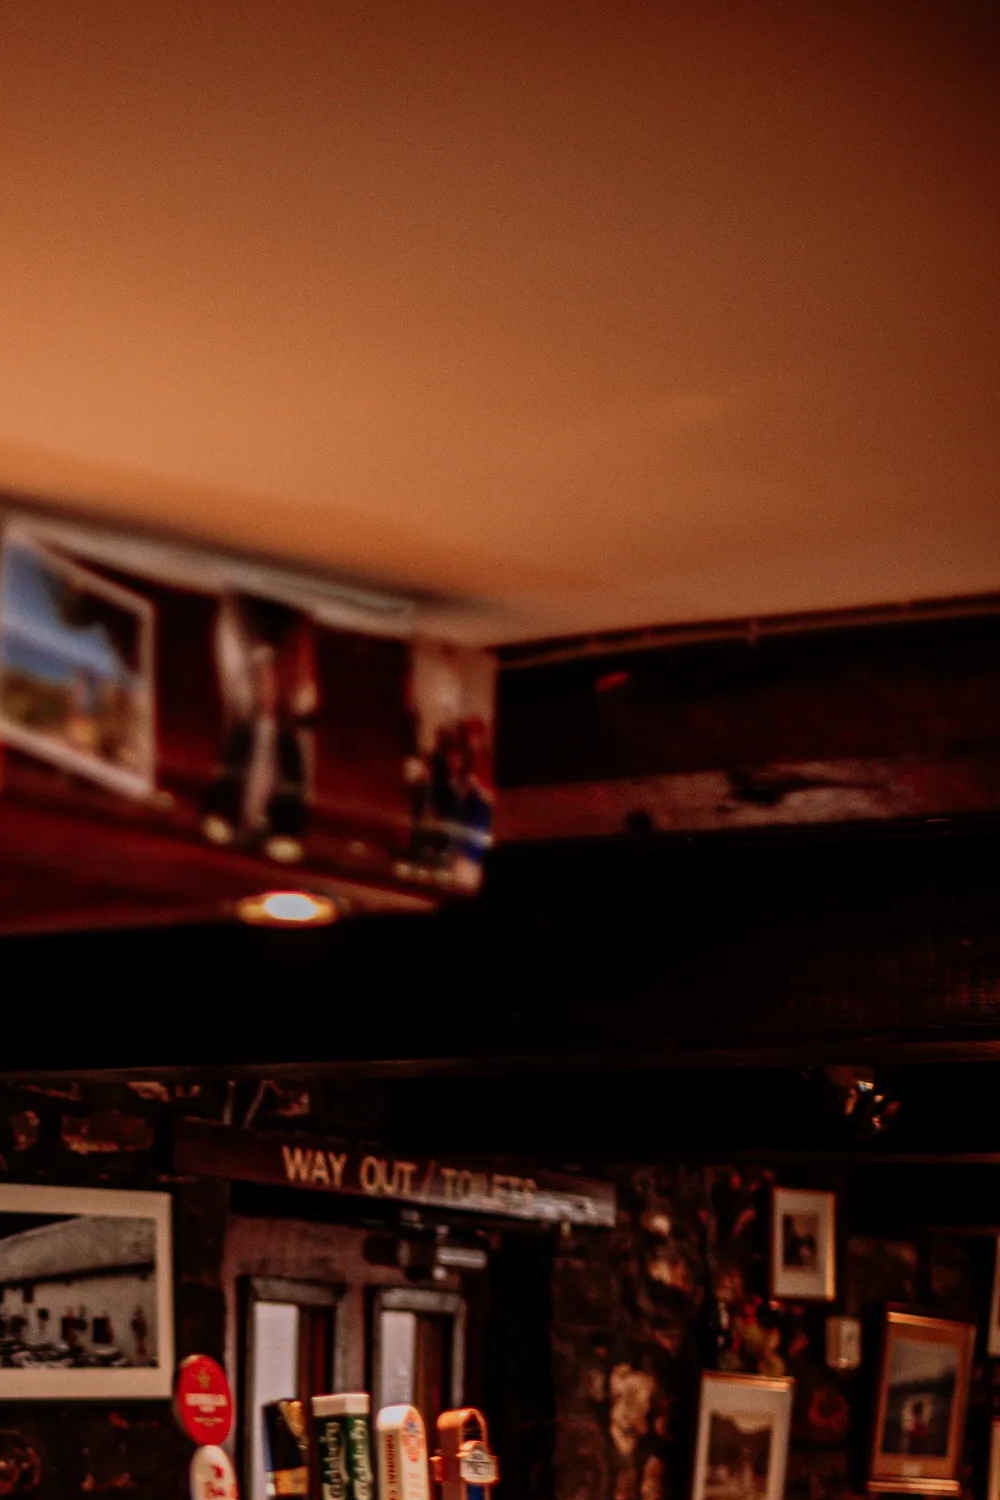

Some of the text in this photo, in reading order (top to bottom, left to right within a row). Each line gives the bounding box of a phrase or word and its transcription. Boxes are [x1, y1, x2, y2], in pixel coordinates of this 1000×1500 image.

[281, 1145, 347, 1187] WAY
[359, 1155, 418, 1195] OUT
[439, 1166, 539, 1204] TOILETS
